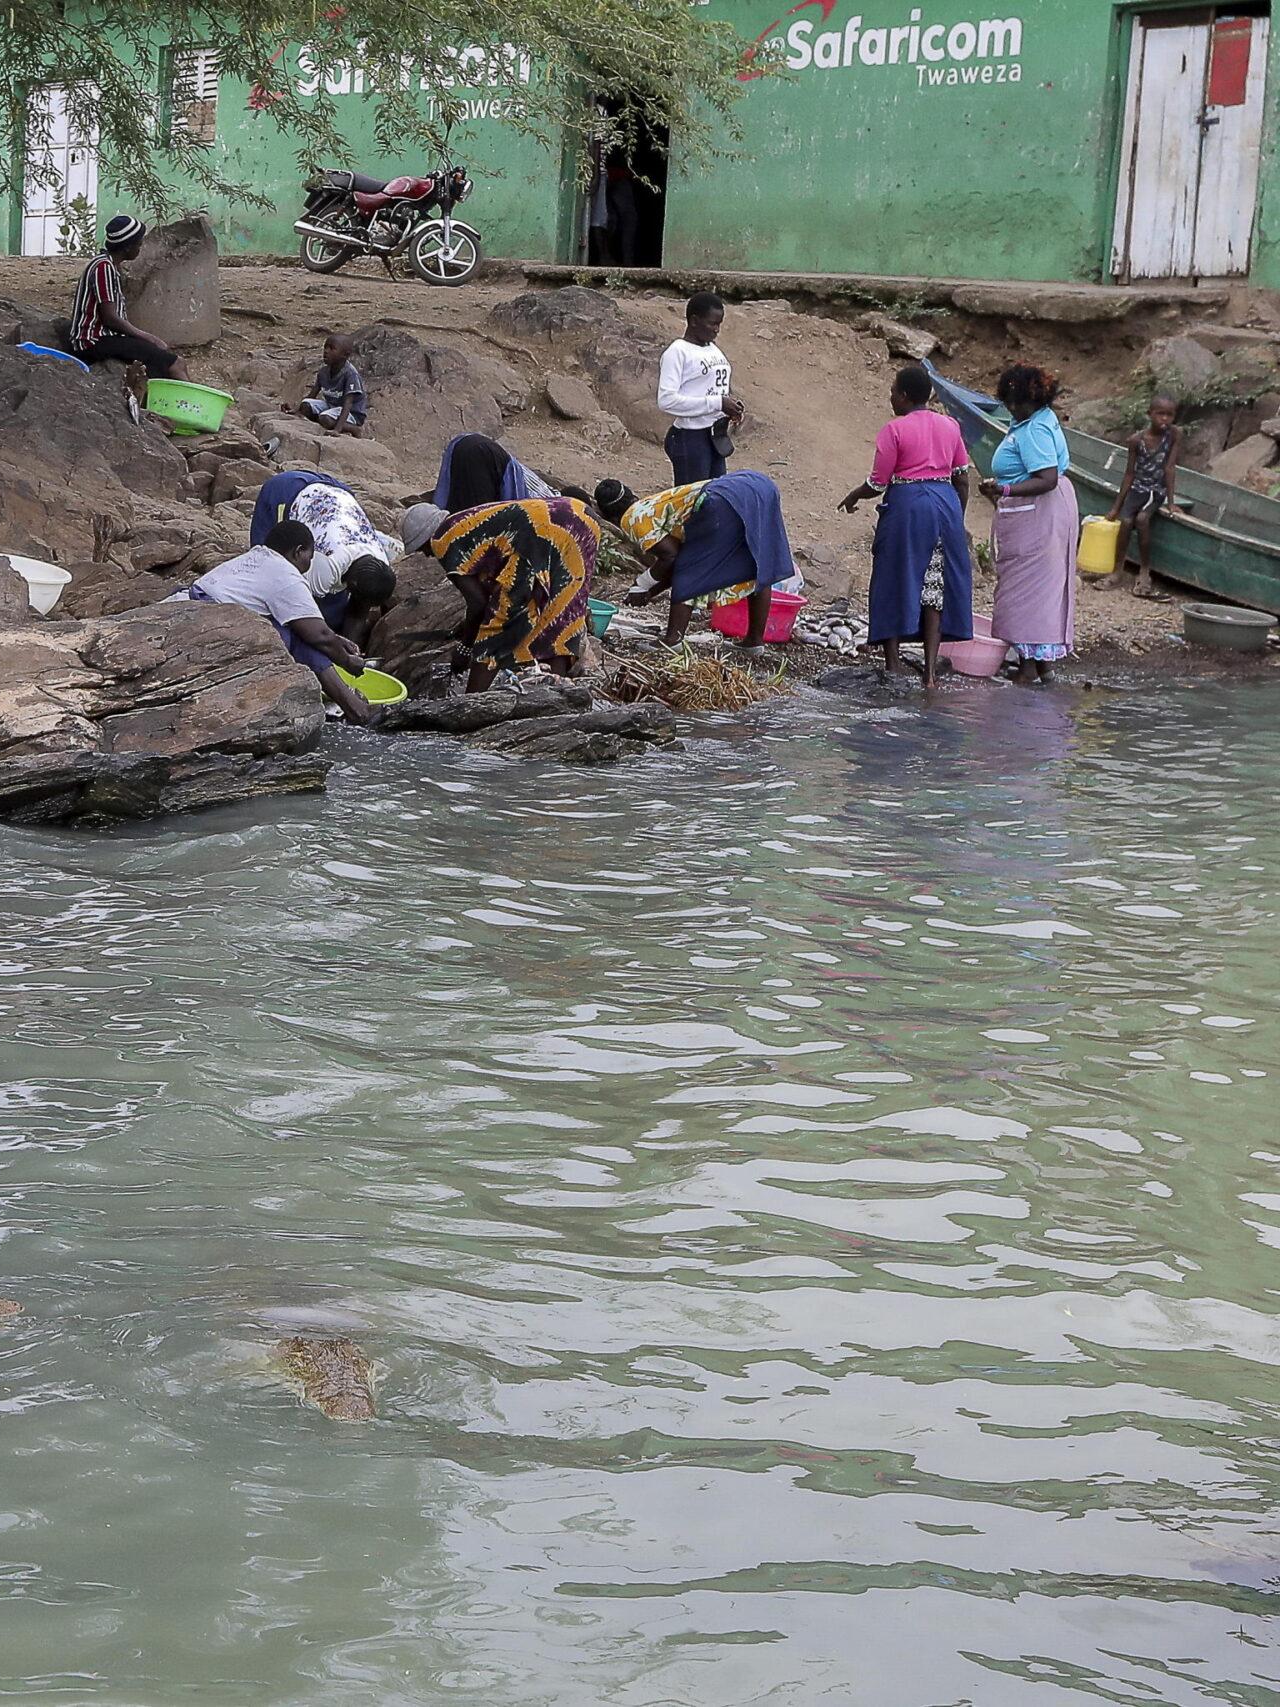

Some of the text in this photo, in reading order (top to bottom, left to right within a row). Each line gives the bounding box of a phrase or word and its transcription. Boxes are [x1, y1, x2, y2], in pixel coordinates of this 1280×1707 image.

[787, 9, 1021, 70] Safaricom
[916, 63, 1021, 87] Twaweza
[715, 368, 728, 387] 22
